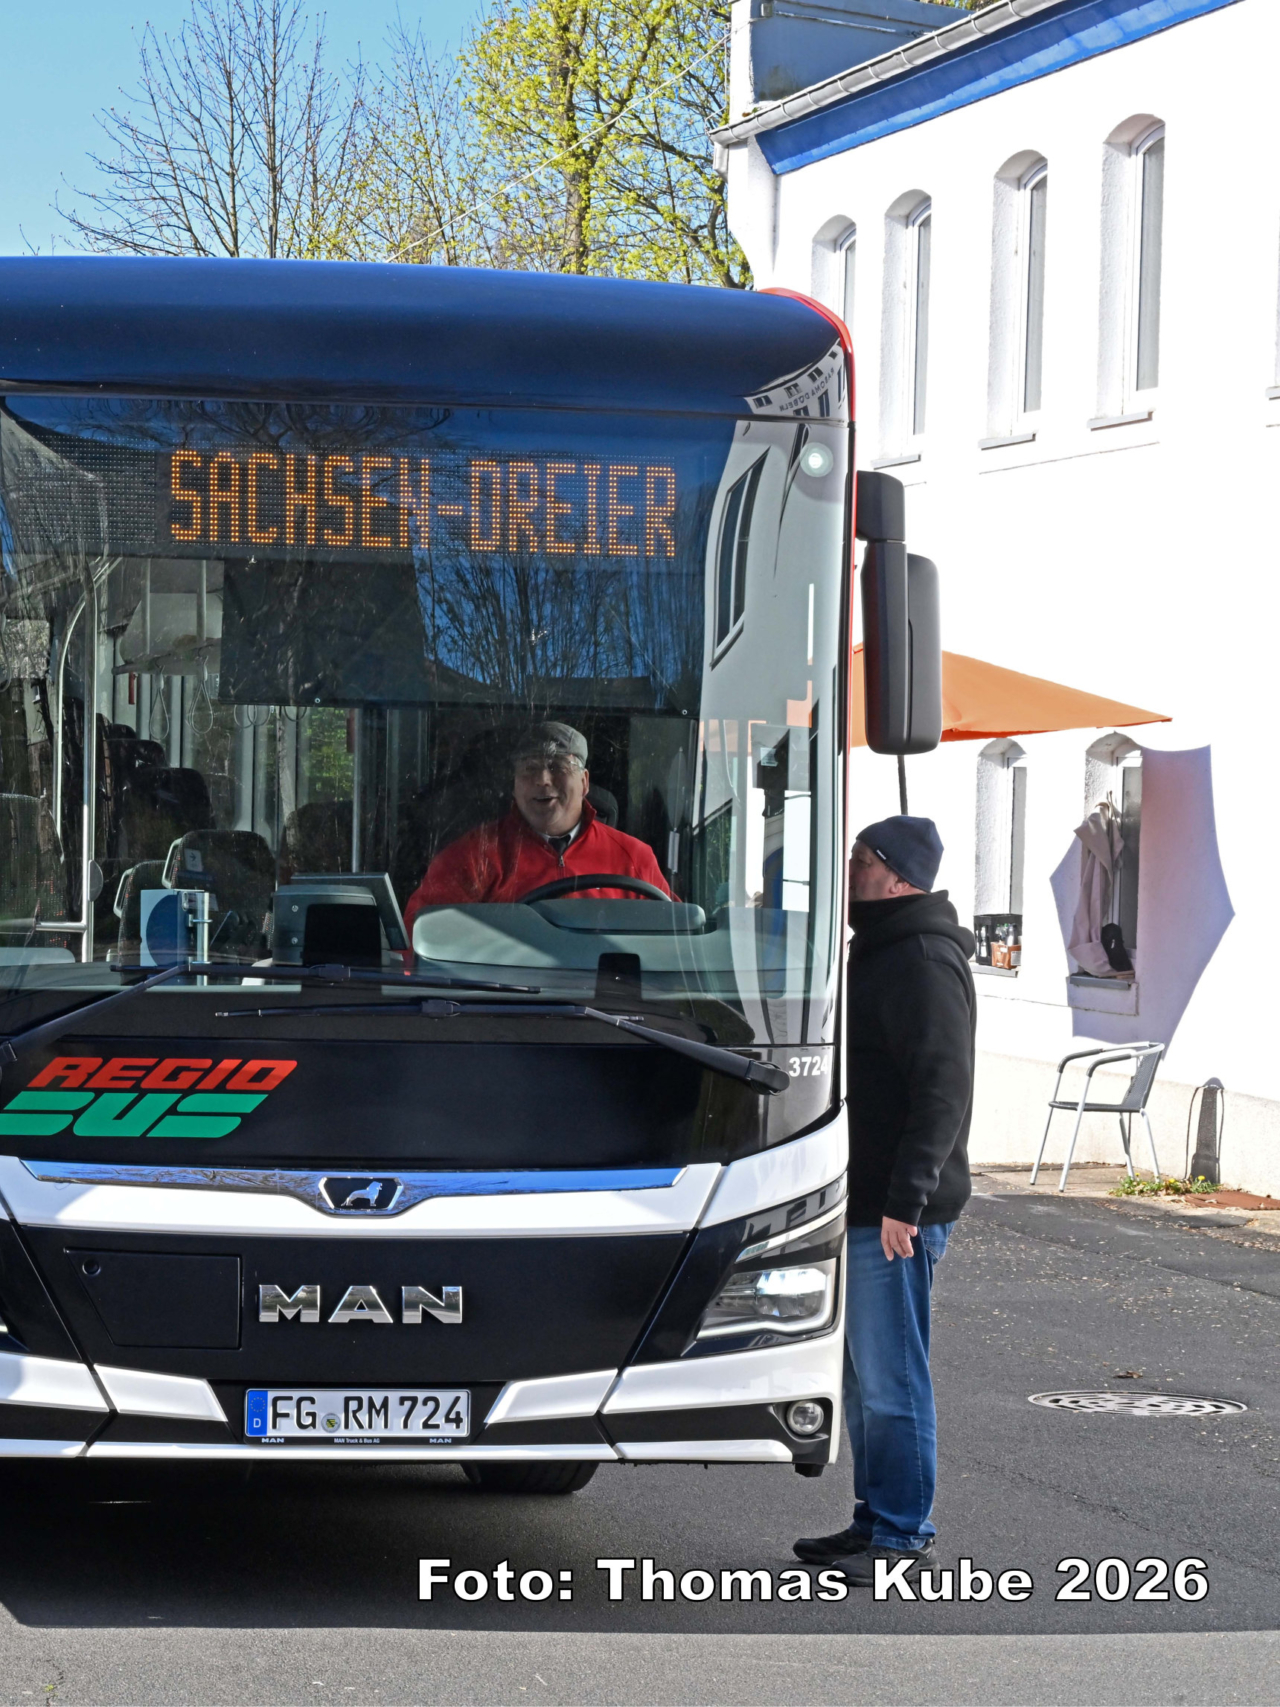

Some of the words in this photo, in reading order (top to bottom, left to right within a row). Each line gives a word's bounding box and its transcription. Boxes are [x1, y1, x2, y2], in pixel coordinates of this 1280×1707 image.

[170, 449, 677, 558] SACHSEN-DREIER
[26, 1056, 298, 1091] REGIO
[789, 1055, 829, 1077] 3724
[258, 1284, 463, 1324] MAN
[253, 1417, 262, 1428] D
[271, 1395, 317, 1430] FG
[343, 1395, 390, 1430] RM
[398, 1395, 464, 1430] 724
